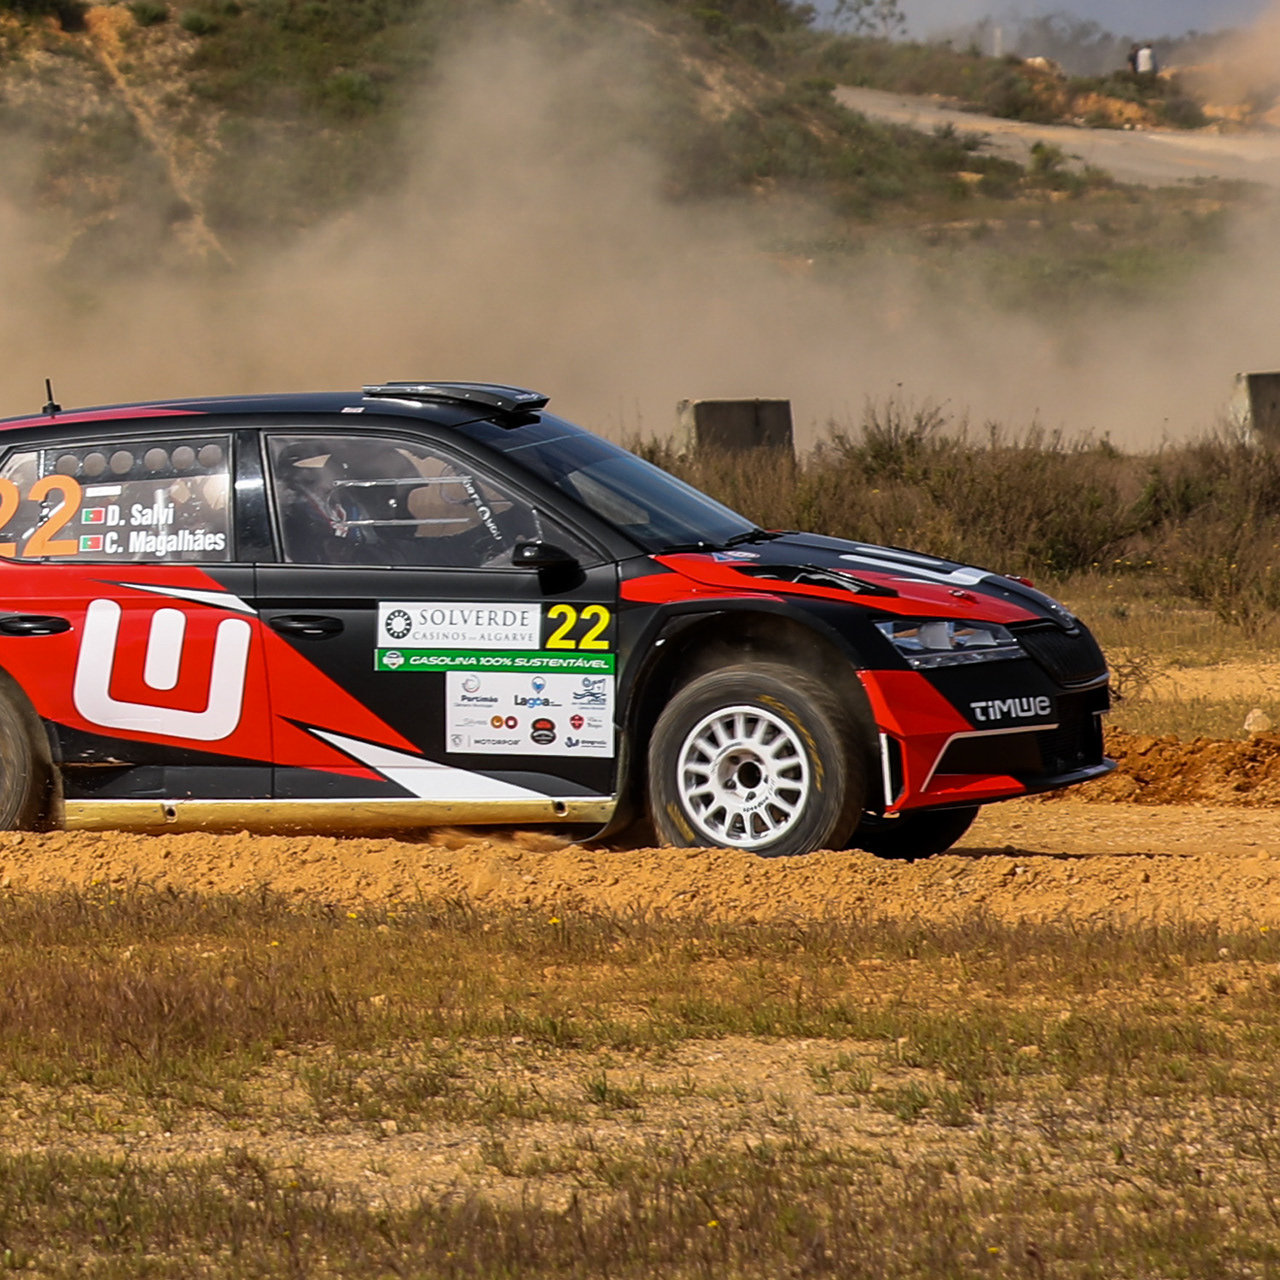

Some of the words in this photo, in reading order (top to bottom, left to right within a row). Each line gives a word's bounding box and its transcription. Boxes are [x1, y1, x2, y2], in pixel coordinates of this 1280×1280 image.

[106, 506, 126, 527] D.
[129, 504, 175, 527] Salvi
[105, 532, 124, 554] C.
[129, 529, 225, 556] Magalhães
[419, 609, 530, 627] SOLVERDE
[545, 604, 611, 650] 22
[412, 631, 467, 641] CASINOS
[479, 632, 534, 642] ALGARVE
[409, 656, 477, 666] GASOLINA
[478, 656, 513, 667] 100%
[514, 656, 609, 669] SUSTENTÁVEL
[514, 695, 550, 708] Lagoa
